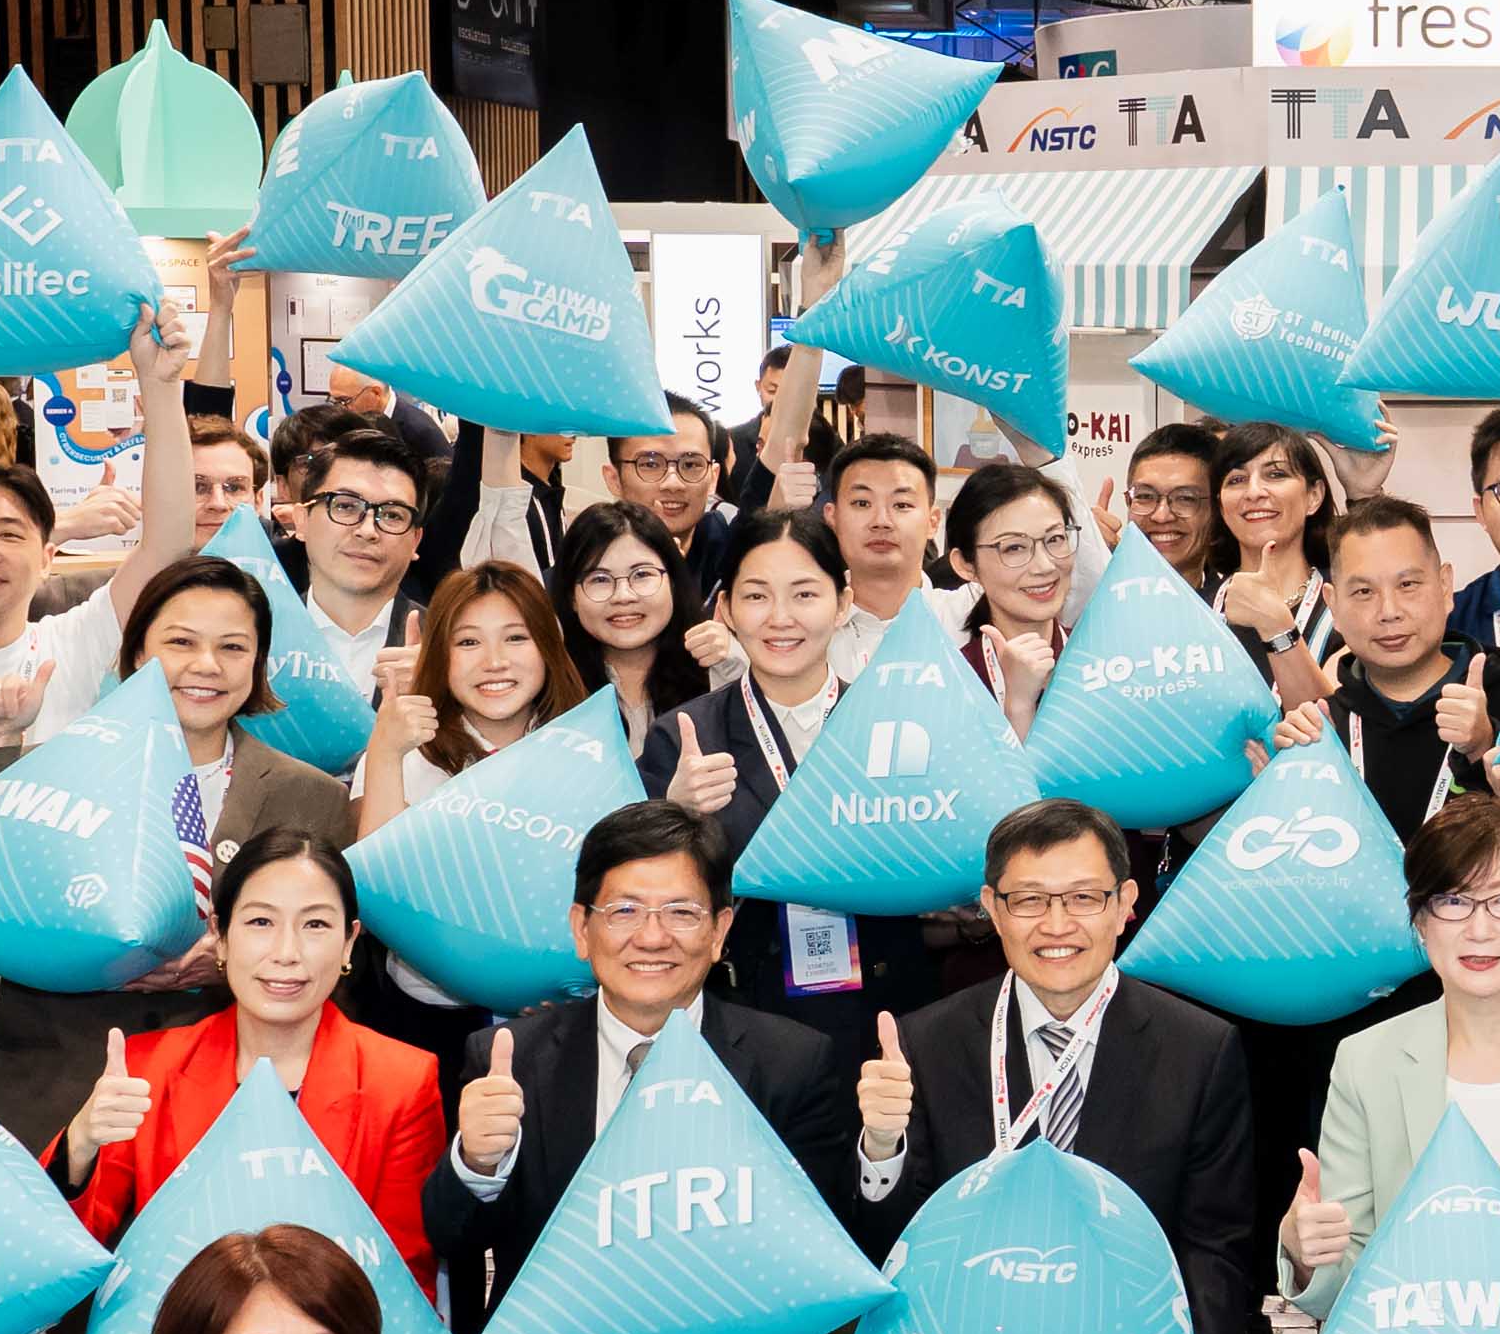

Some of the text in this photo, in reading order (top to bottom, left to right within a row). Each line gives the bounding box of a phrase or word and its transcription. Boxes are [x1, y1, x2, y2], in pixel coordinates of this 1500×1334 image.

[1118, 94, 1206, 147] TTA
[1271, 88, 1410, 140] TTA
[381, 132, 439, 161] TTA
[1030, 124, 1096, 152] NSTC
[529, 191, 592, 229] TTA
[1300, 236, 1349, 269] TTA
[531, 277, 612, 318] TAIWAN
[972, 269, 1028, 309] TTA
[522, 297, 605, 338] CAMP
[685, 295, 721, 412] works
[1071, 441, 1114, 458] express
[1110, 577, 1179, 602] TTA
[875, 660, 946, 688] TTA
[1121, 677, 1200, 701] express
[1272, 761, 1340, 784] TTA
[832, 789, 959, 826] NunoX
[638, 1077, 722, 1108] TTA
[239, 1144, 329, 1180] TTA
[596, 1165, 754, 1248] ITRI
[989, 1256, 1078, 1283] NSTC
